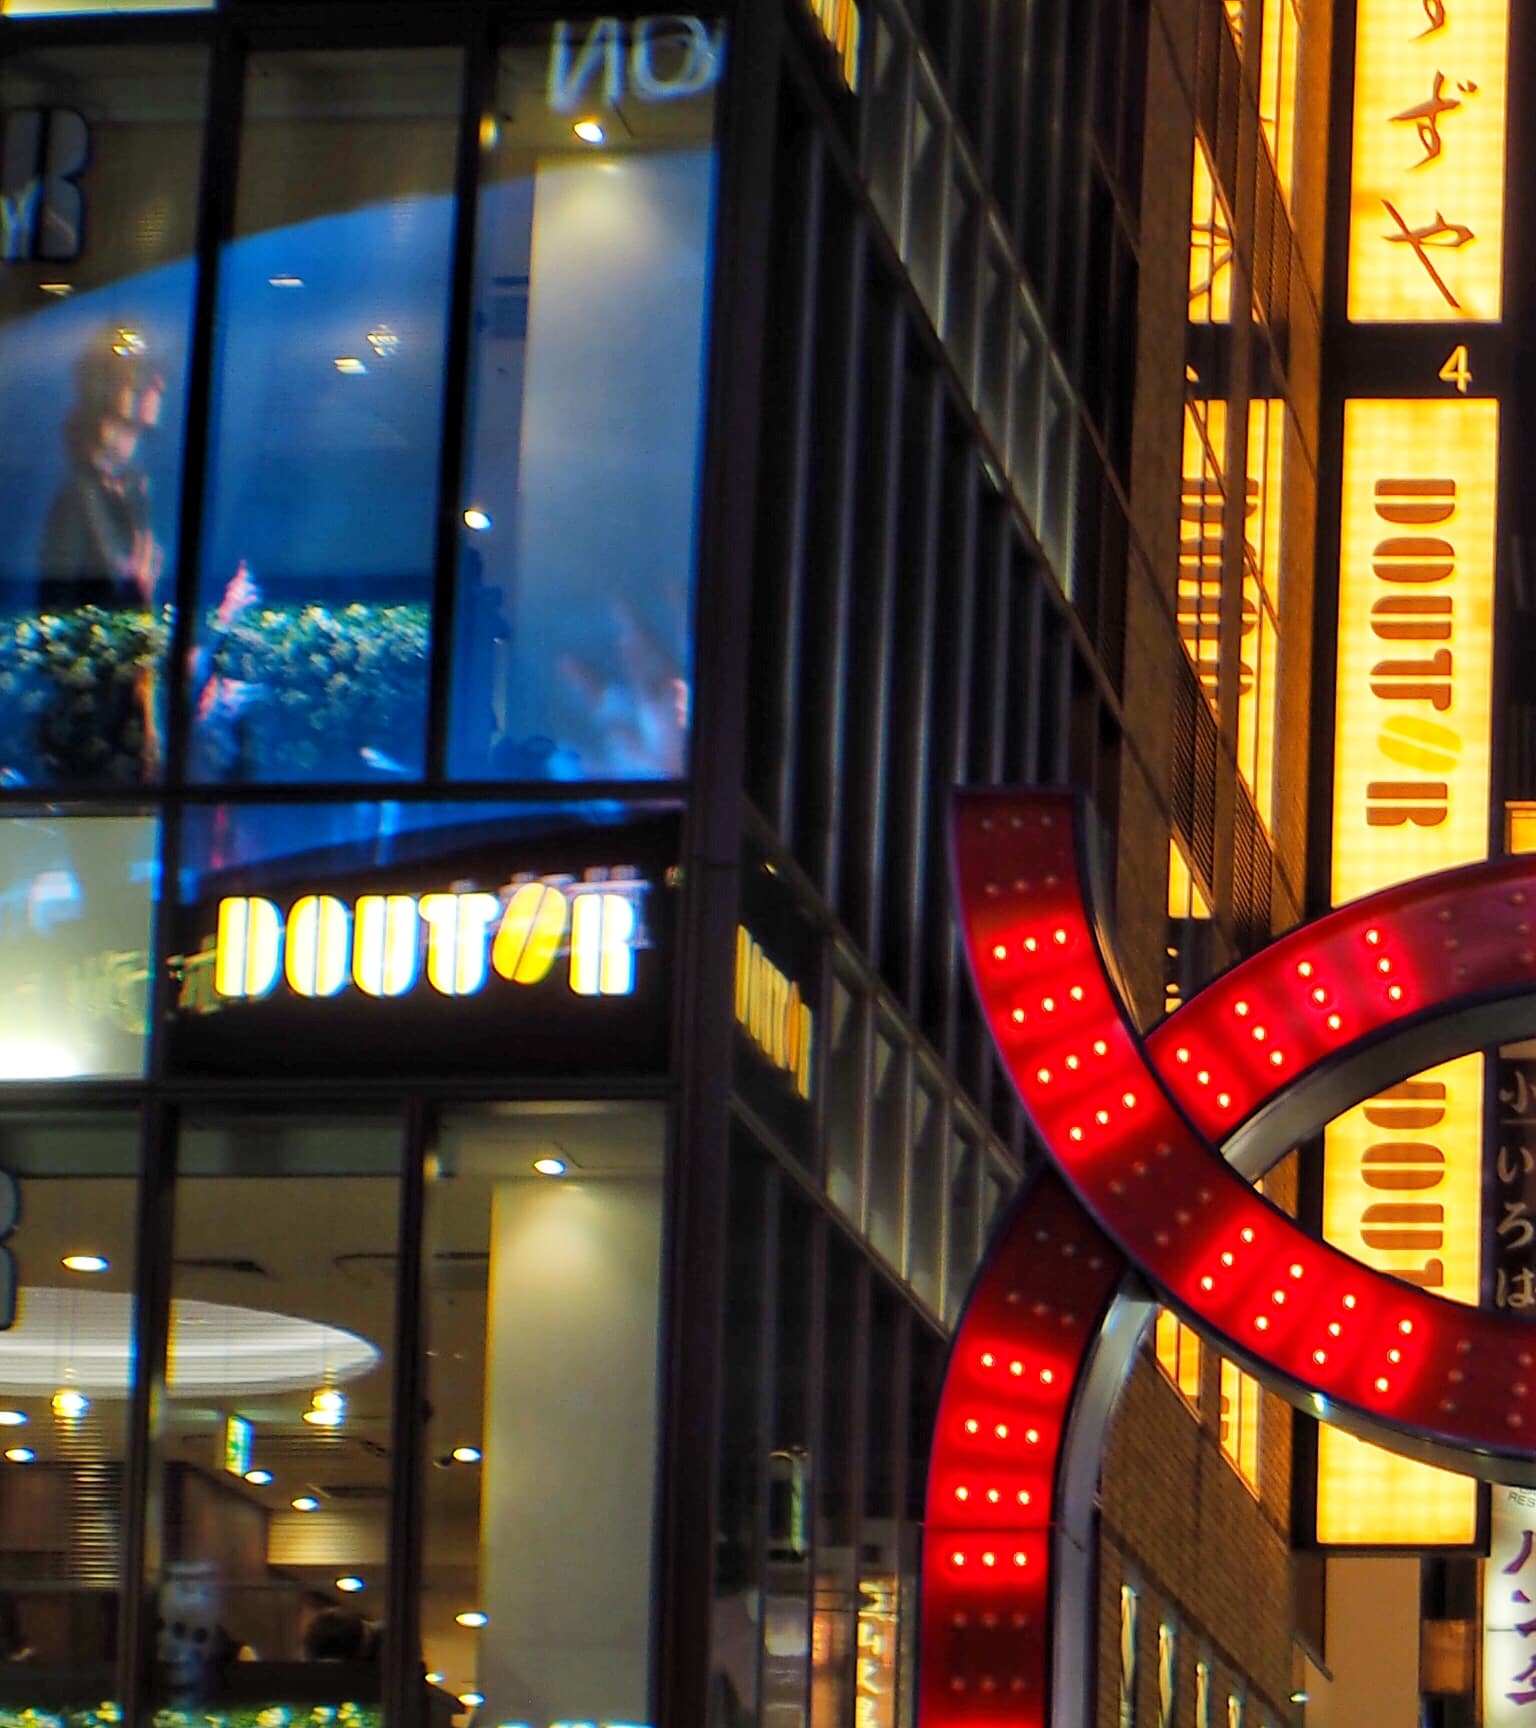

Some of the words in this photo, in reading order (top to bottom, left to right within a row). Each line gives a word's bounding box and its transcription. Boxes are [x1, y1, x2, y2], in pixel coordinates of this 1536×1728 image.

[1437, 346, 1472, 393] 4
[1366, 478, 1462, 828] DOUTOR
[215, 882, 634, 997] DOUTOR
